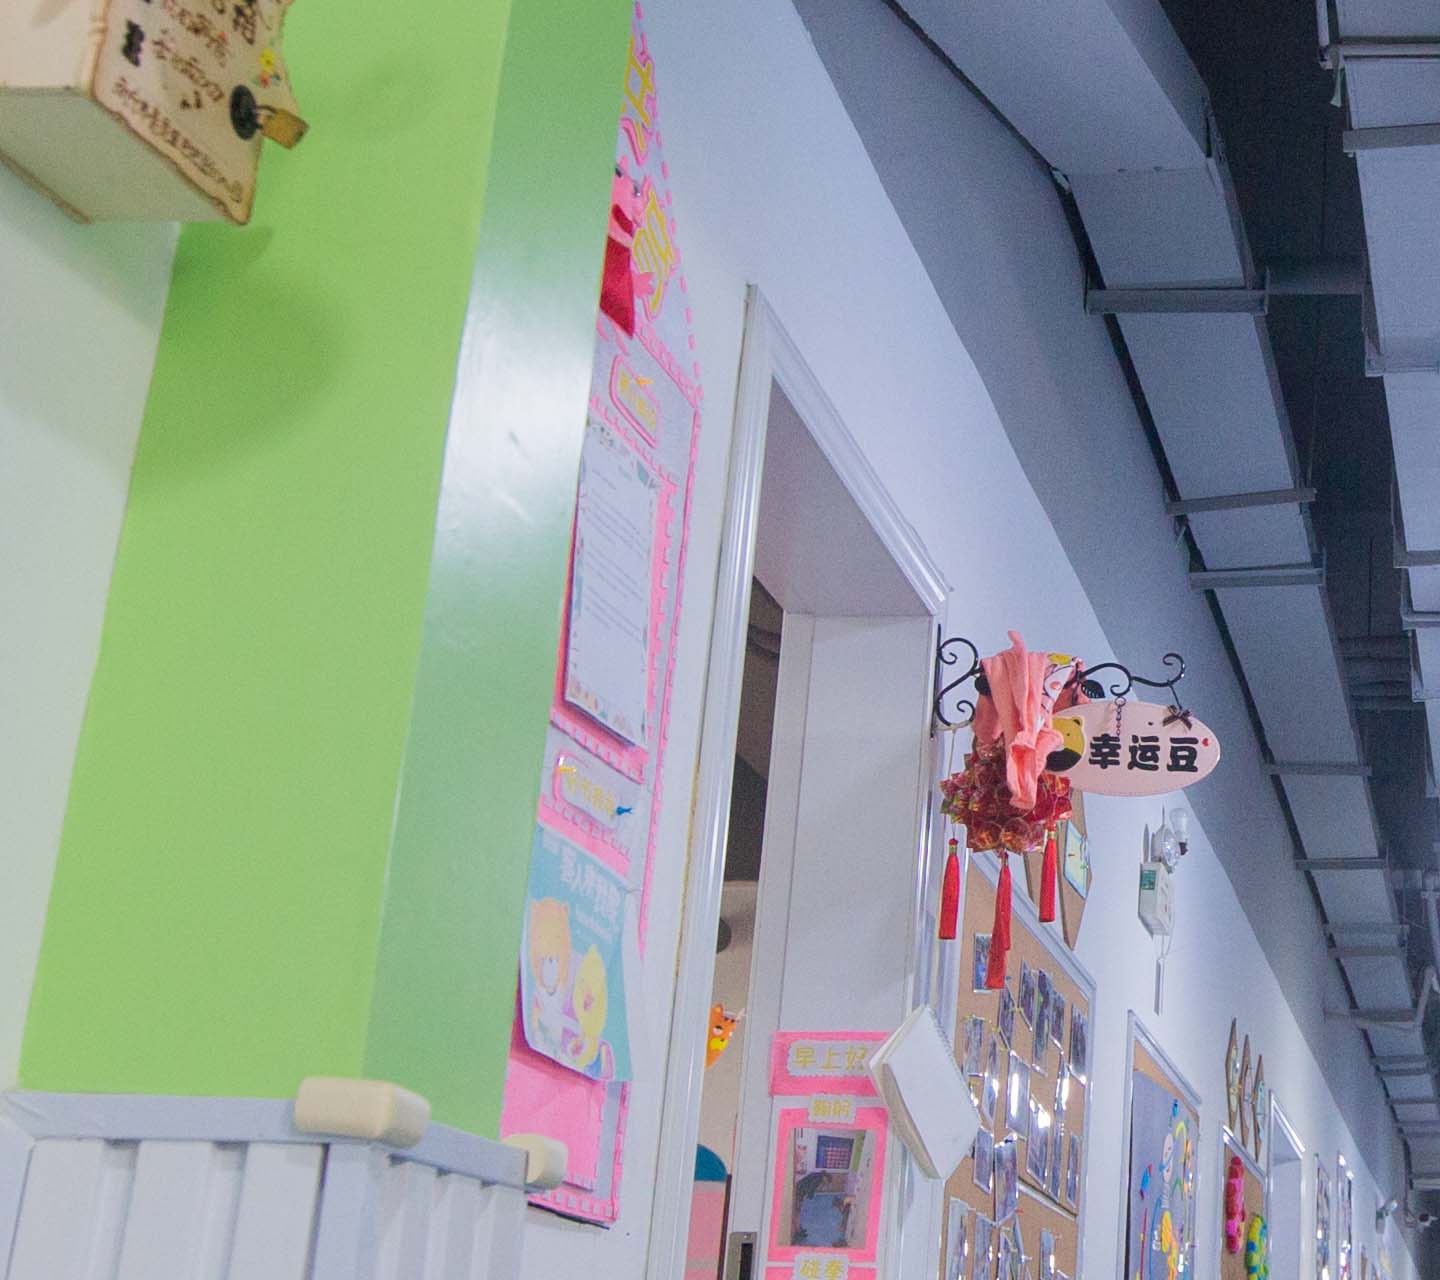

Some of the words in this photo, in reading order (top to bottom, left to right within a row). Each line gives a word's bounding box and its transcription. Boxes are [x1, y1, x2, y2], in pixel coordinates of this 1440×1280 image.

[1088, 732, 1200, 772] 幸运豆
[793, 1045, 870, 1072] 早上好
